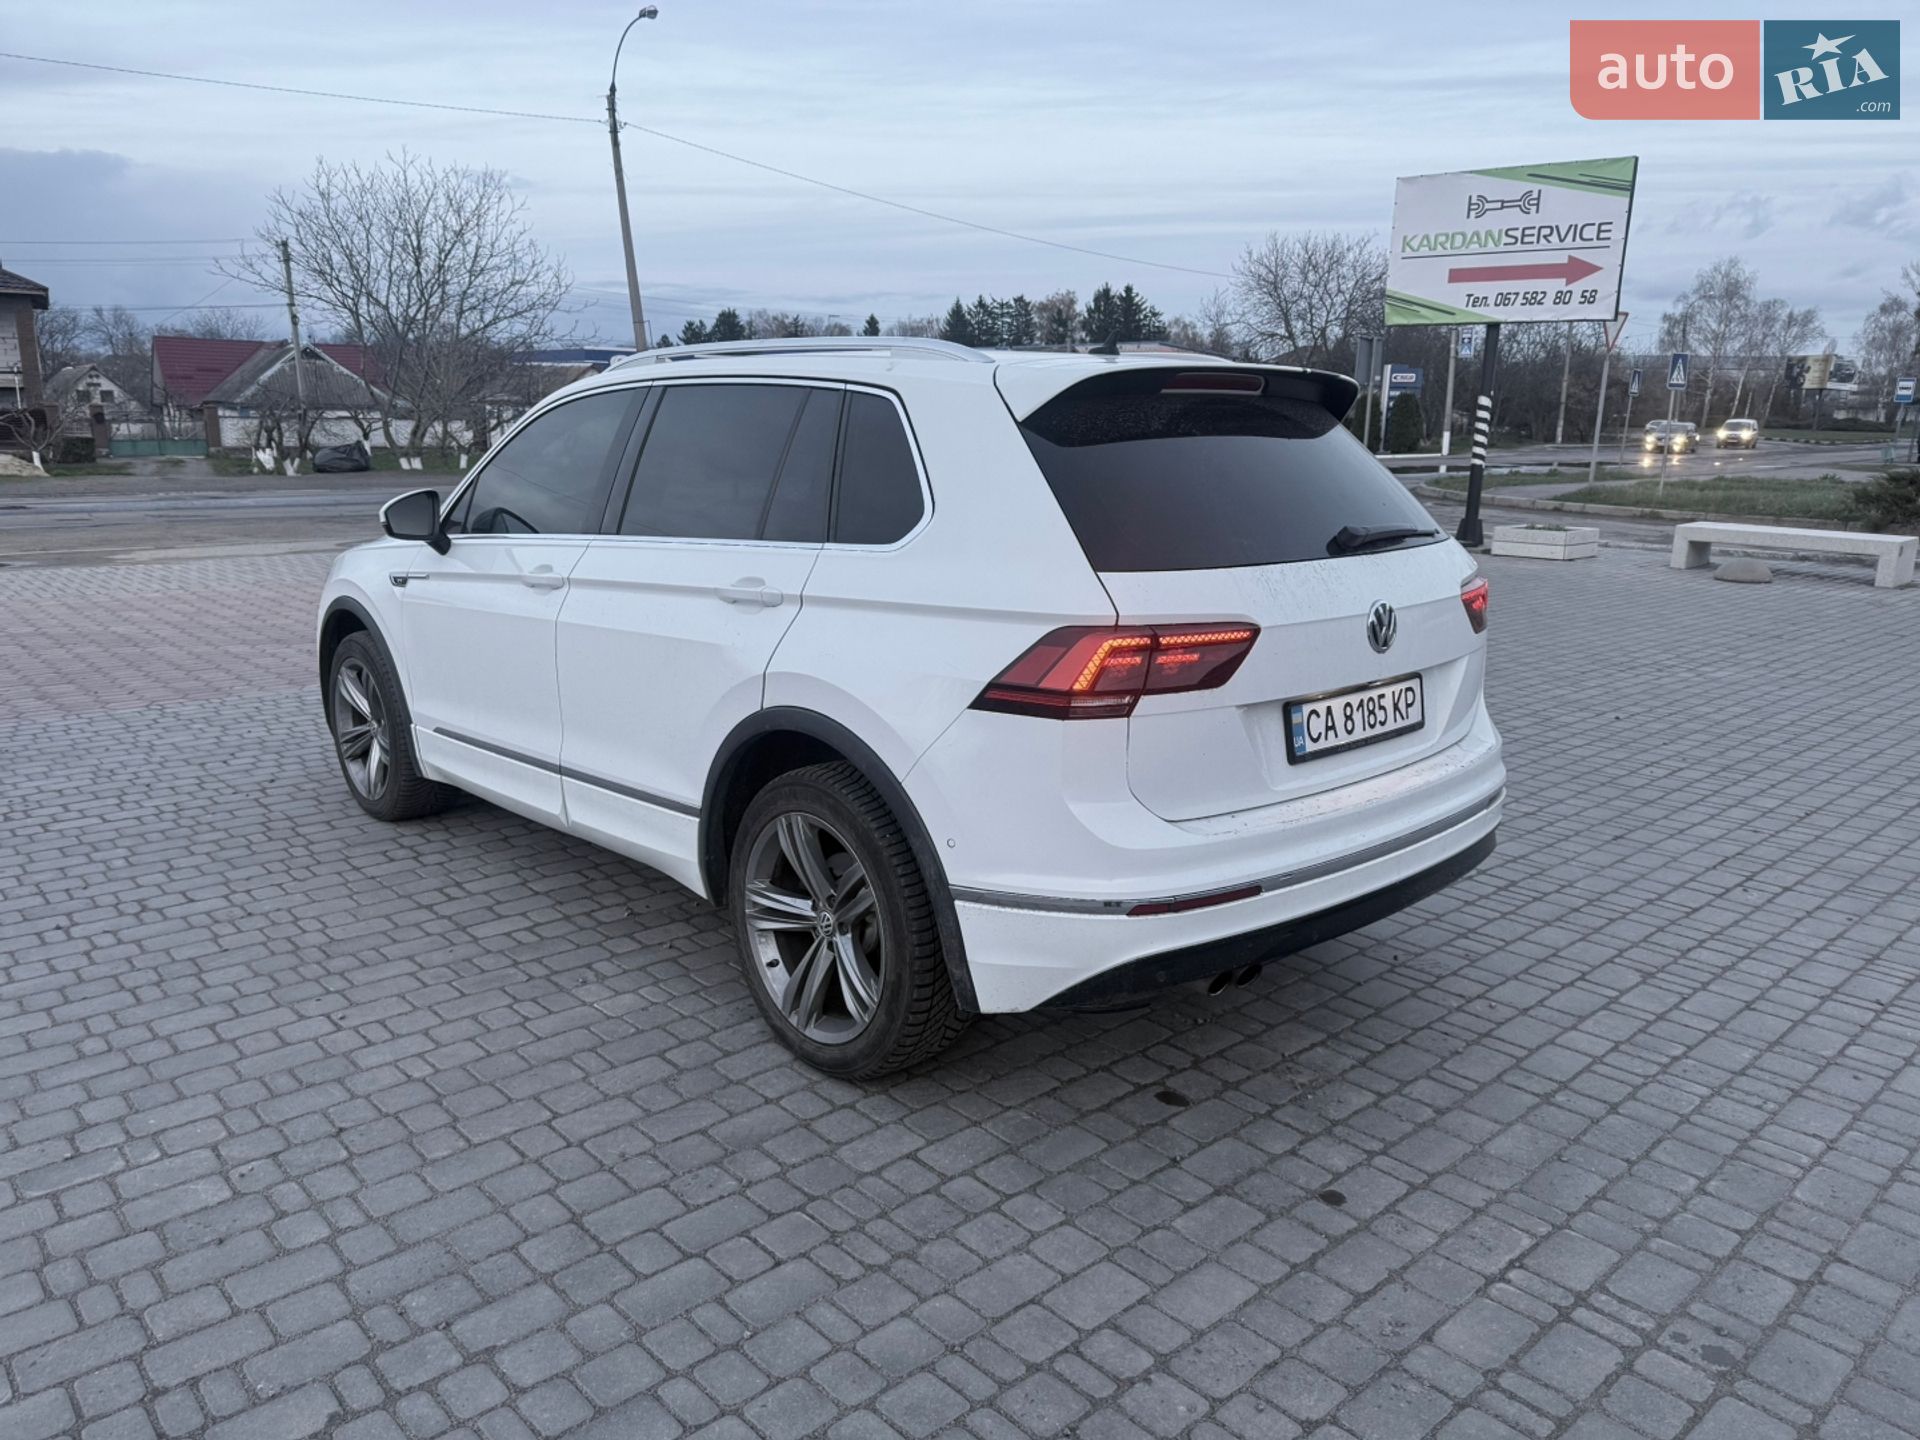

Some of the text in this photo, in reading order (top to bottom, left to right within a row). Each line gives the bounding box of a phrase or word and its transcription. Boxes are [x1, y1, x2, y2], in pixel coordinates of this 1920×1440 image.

[1494, 291, 1518, 307] 067
[1521, 291, 1547, 306] 582
[1553, 290, 1573, 305] 80
[1577, 289, 1598, 304] 58
[1306, 705, 1338, 743] CA
[1343, 693, 1388, 735] 8185
[1392, 686, 1416, 723] KP
